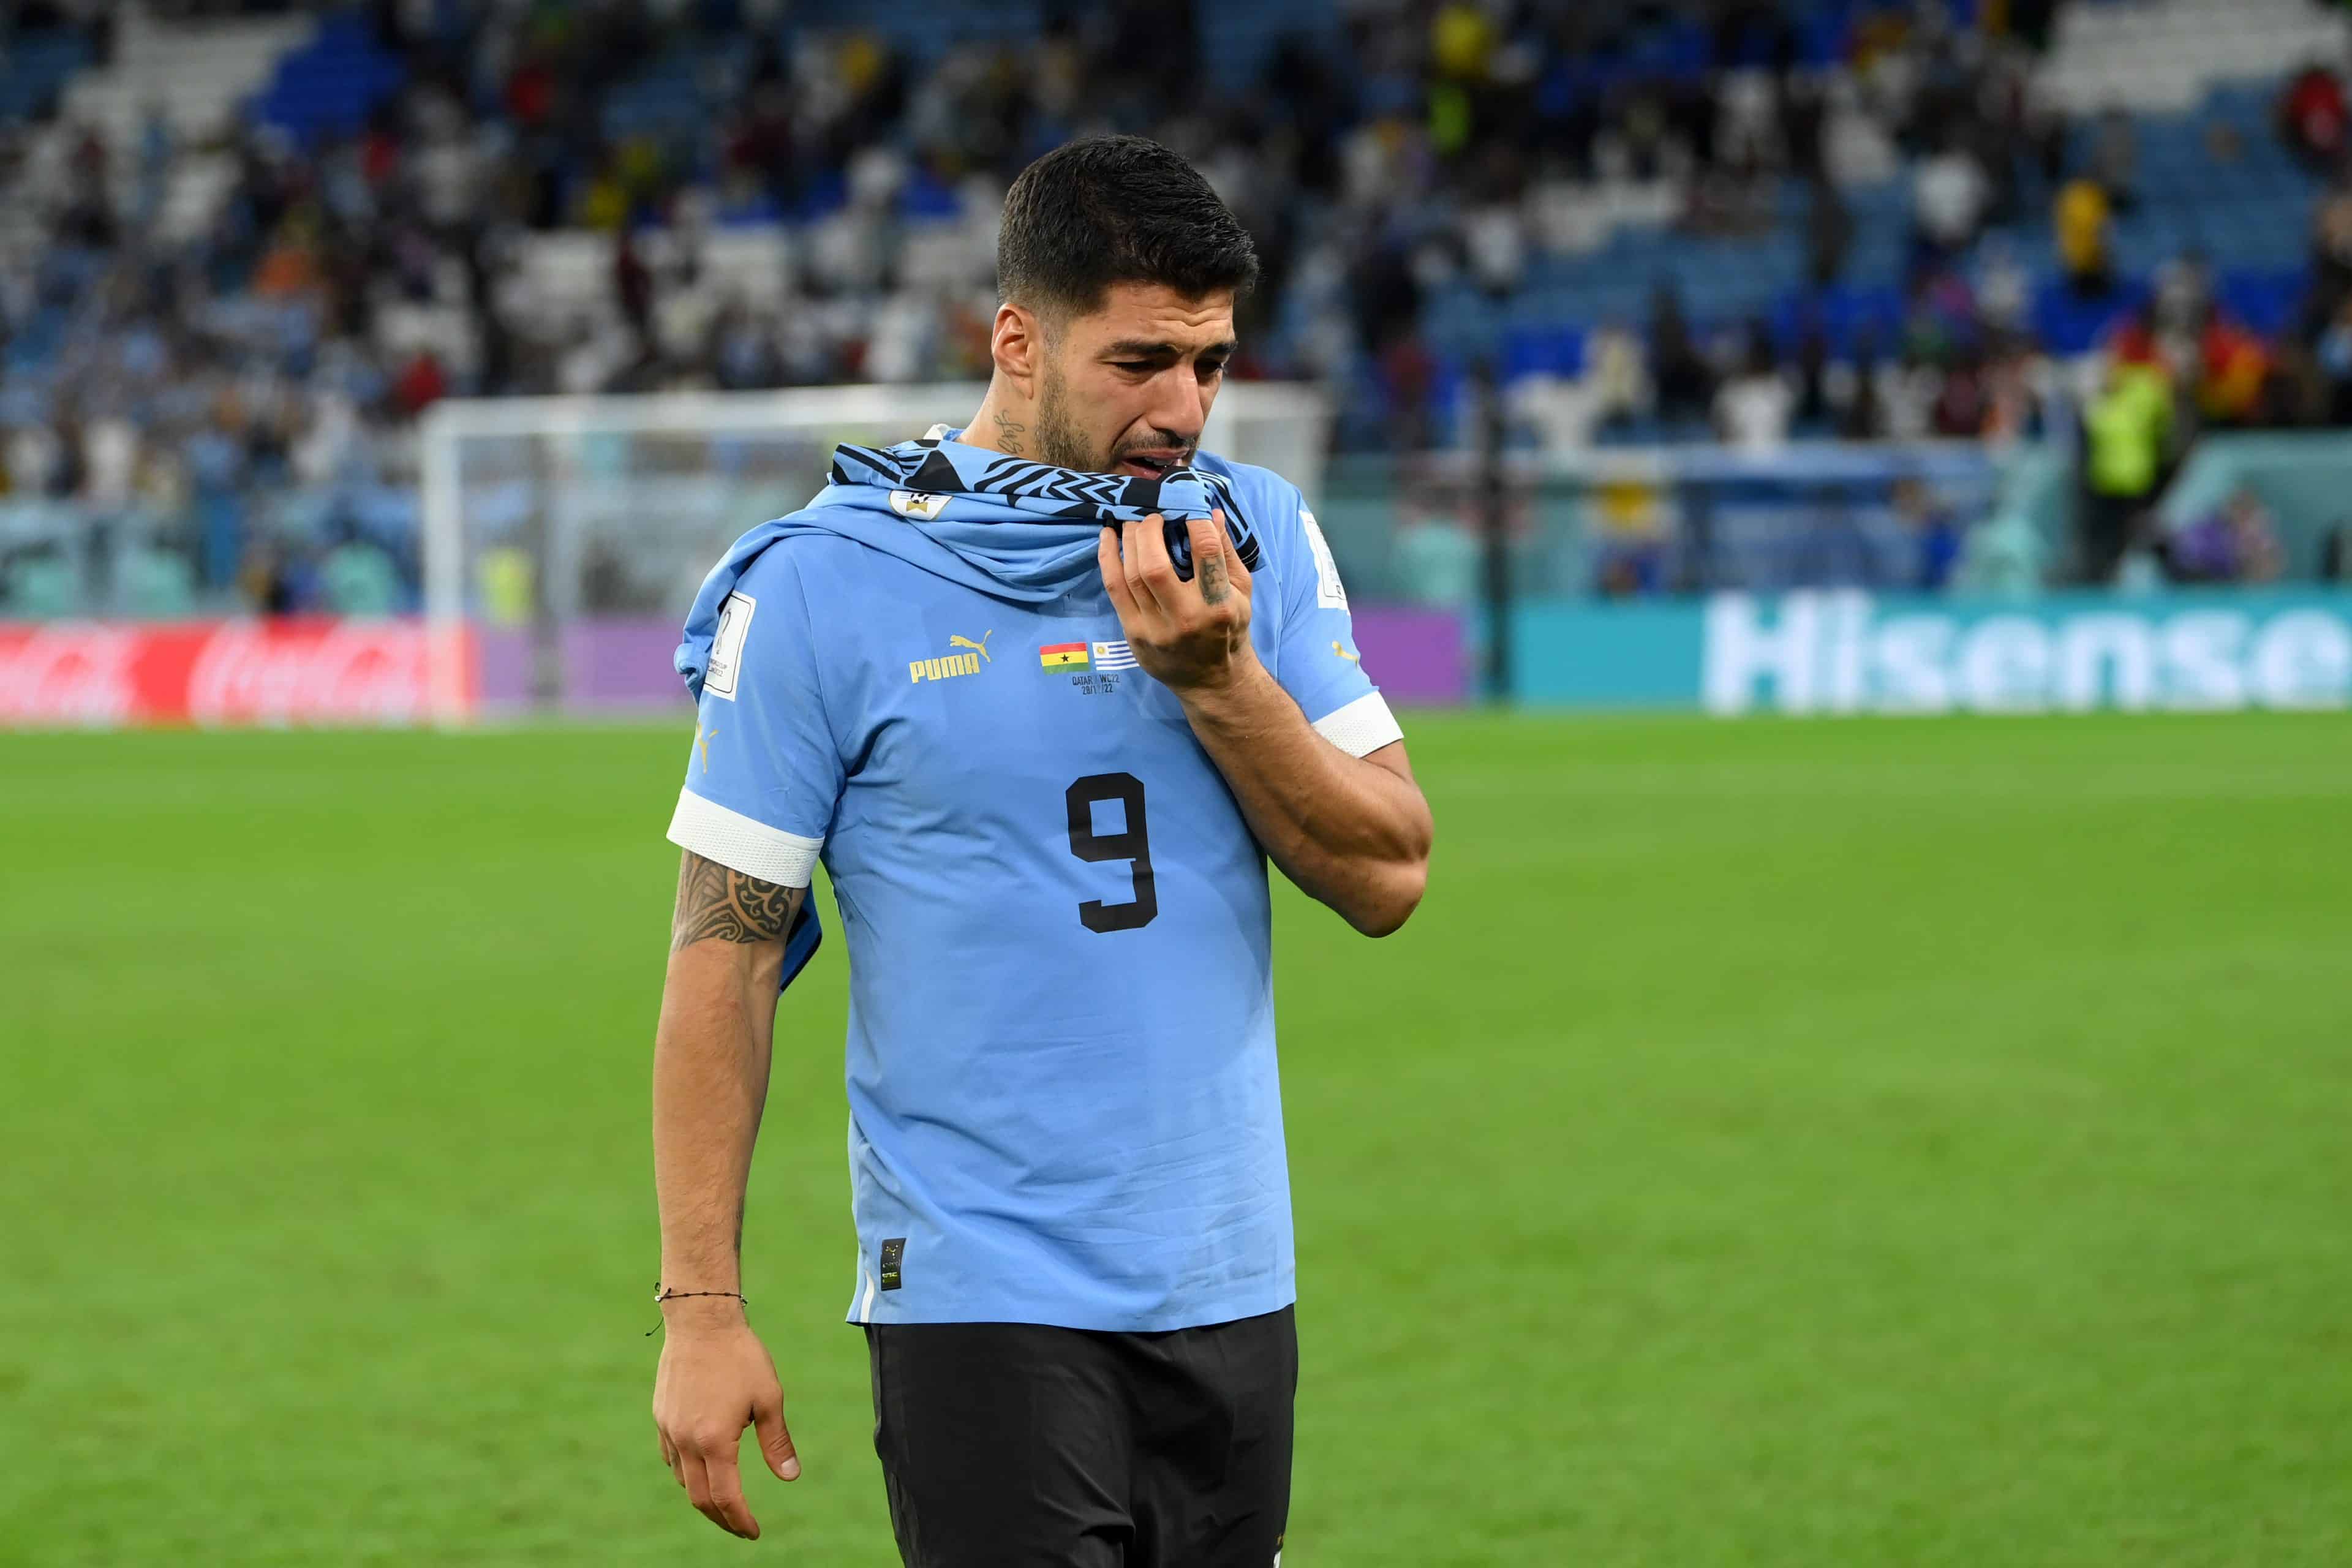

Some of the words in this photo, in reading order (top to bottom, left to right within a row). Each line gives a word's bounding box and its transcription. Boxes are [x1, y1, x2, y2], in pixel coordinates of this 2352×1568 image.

[909, 652, 980, 683] PUMA
[1072, 676, 1093, 686] QATAR
[1703, 589, 2351, 714] Hisense
[1065, 772, 1158, 933] 9
